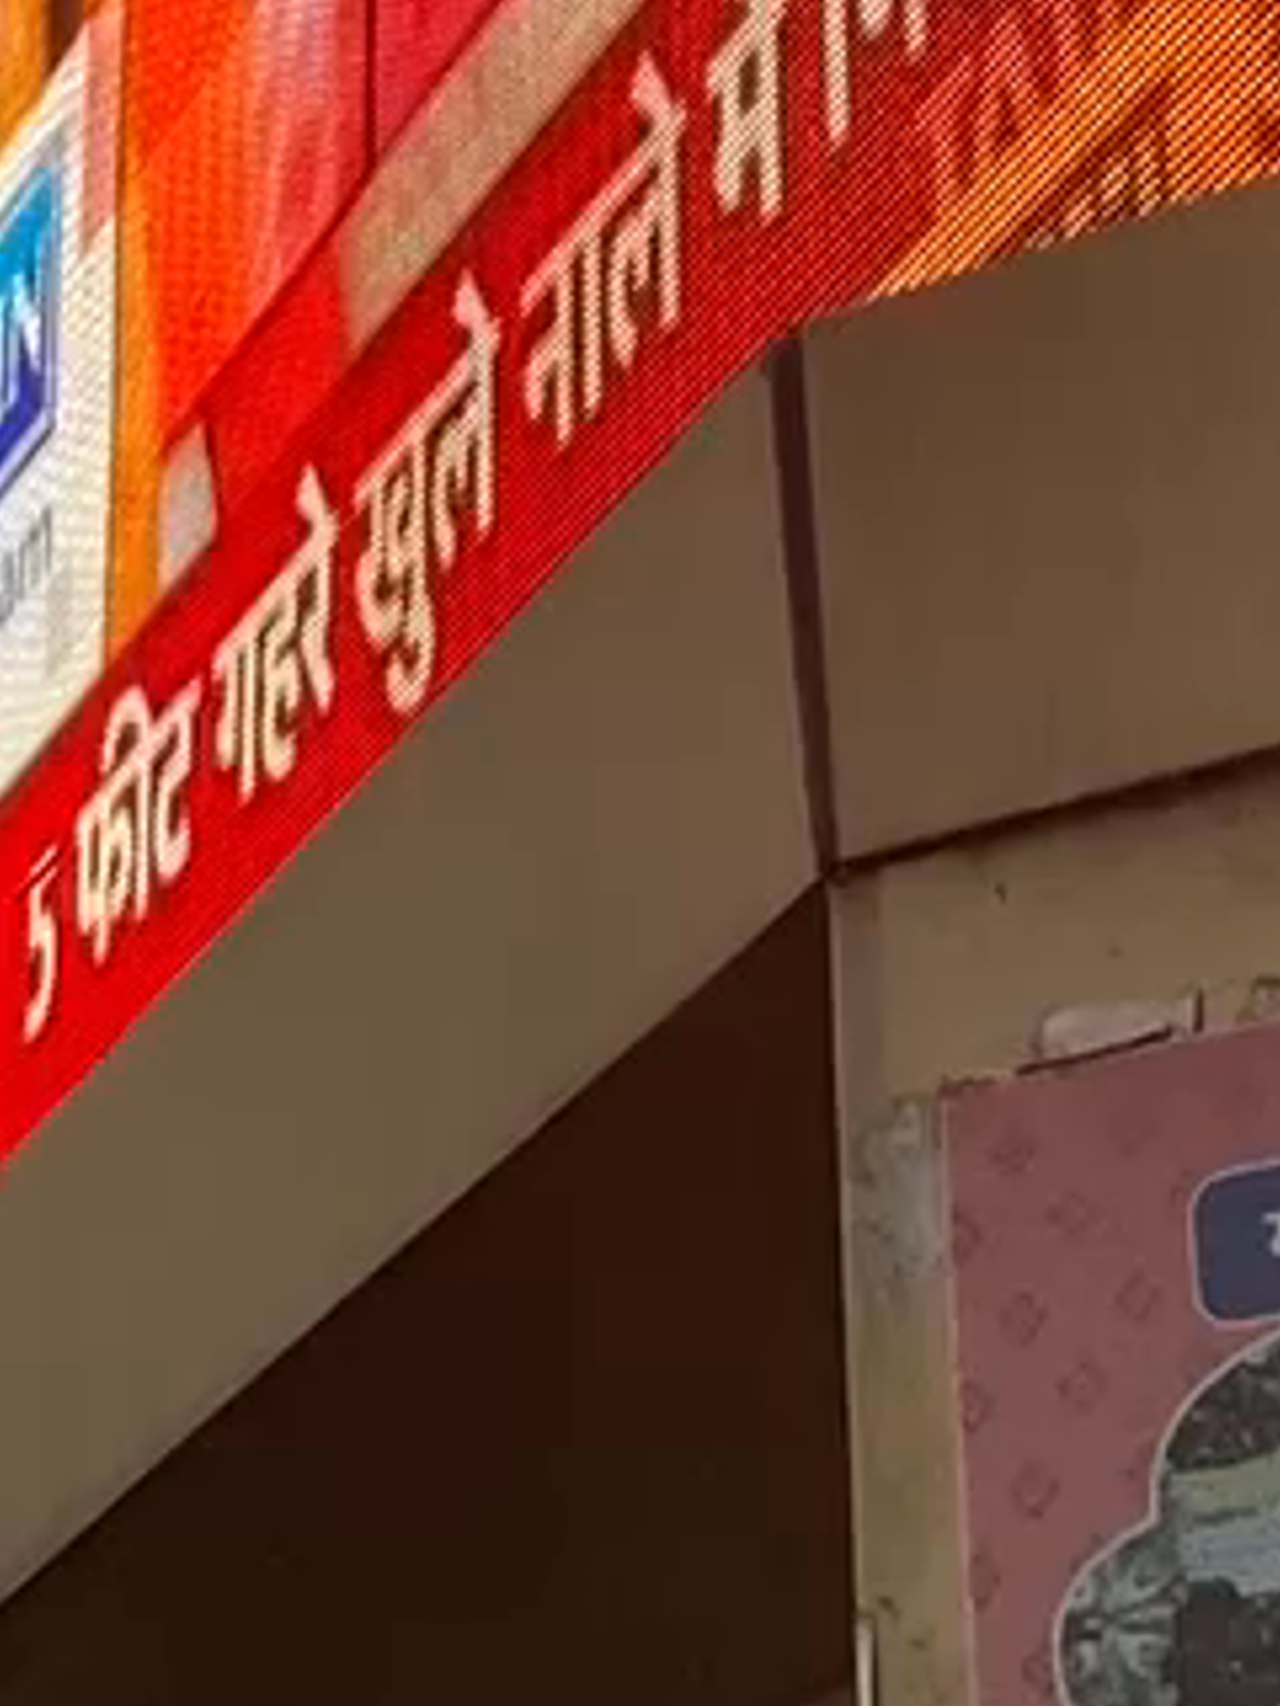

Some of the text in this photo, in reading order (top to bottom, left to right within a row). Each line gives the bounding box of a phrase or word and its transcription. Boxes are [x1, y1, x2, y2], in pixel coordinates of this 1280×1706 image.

[22, 842, 58, 1042] 5
[76, 680, 196, 962] फीट
[215, 463, 337, 806] गहरे
[357, 271, 502, 714] खुले
[523, 50, 686, 448] नाले
